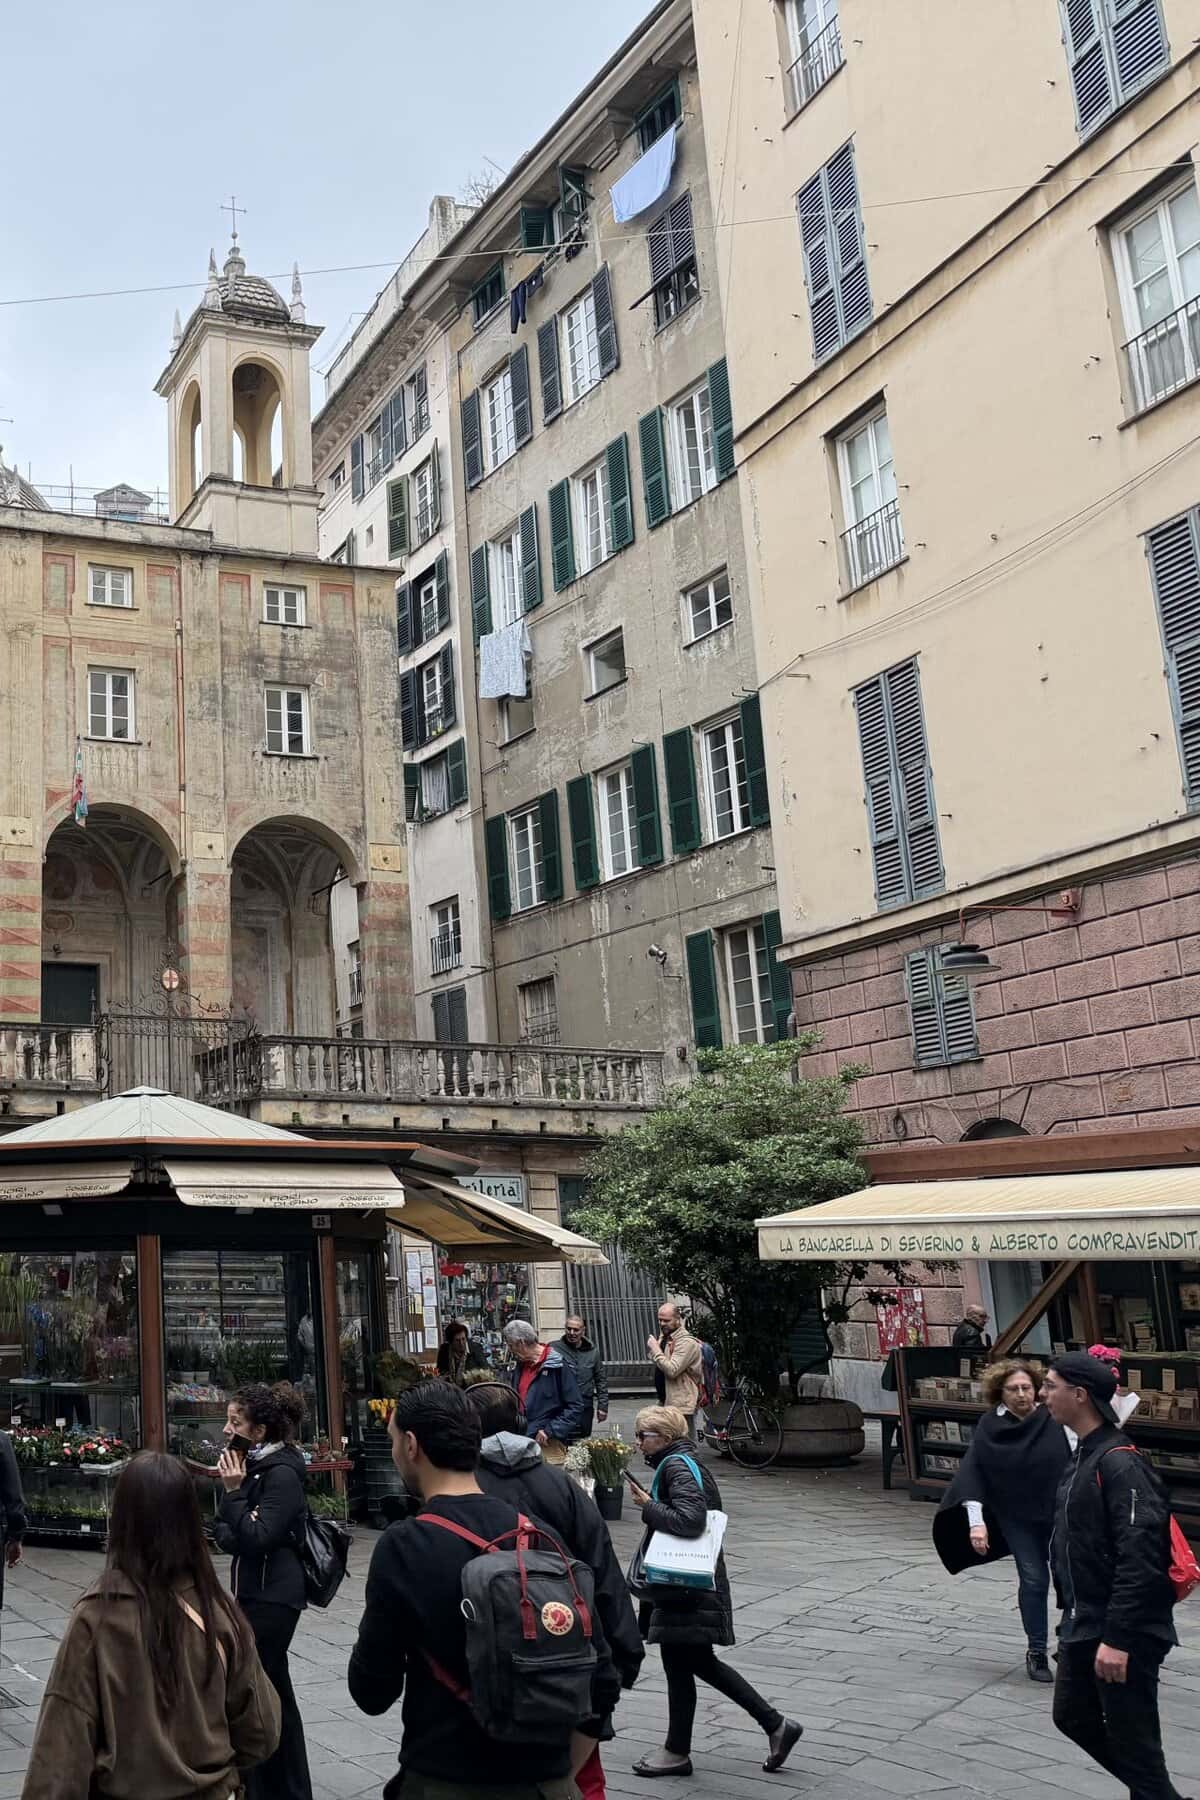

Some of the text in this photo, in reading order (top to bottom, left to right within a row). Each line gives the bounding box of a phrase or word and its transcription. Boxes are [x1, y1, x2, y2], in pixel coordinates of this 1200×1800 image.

[778, 1230, 1200, 1253] LA BANCARELLA DI SEVERINO & ALBERTO COMPRAVENDIT
